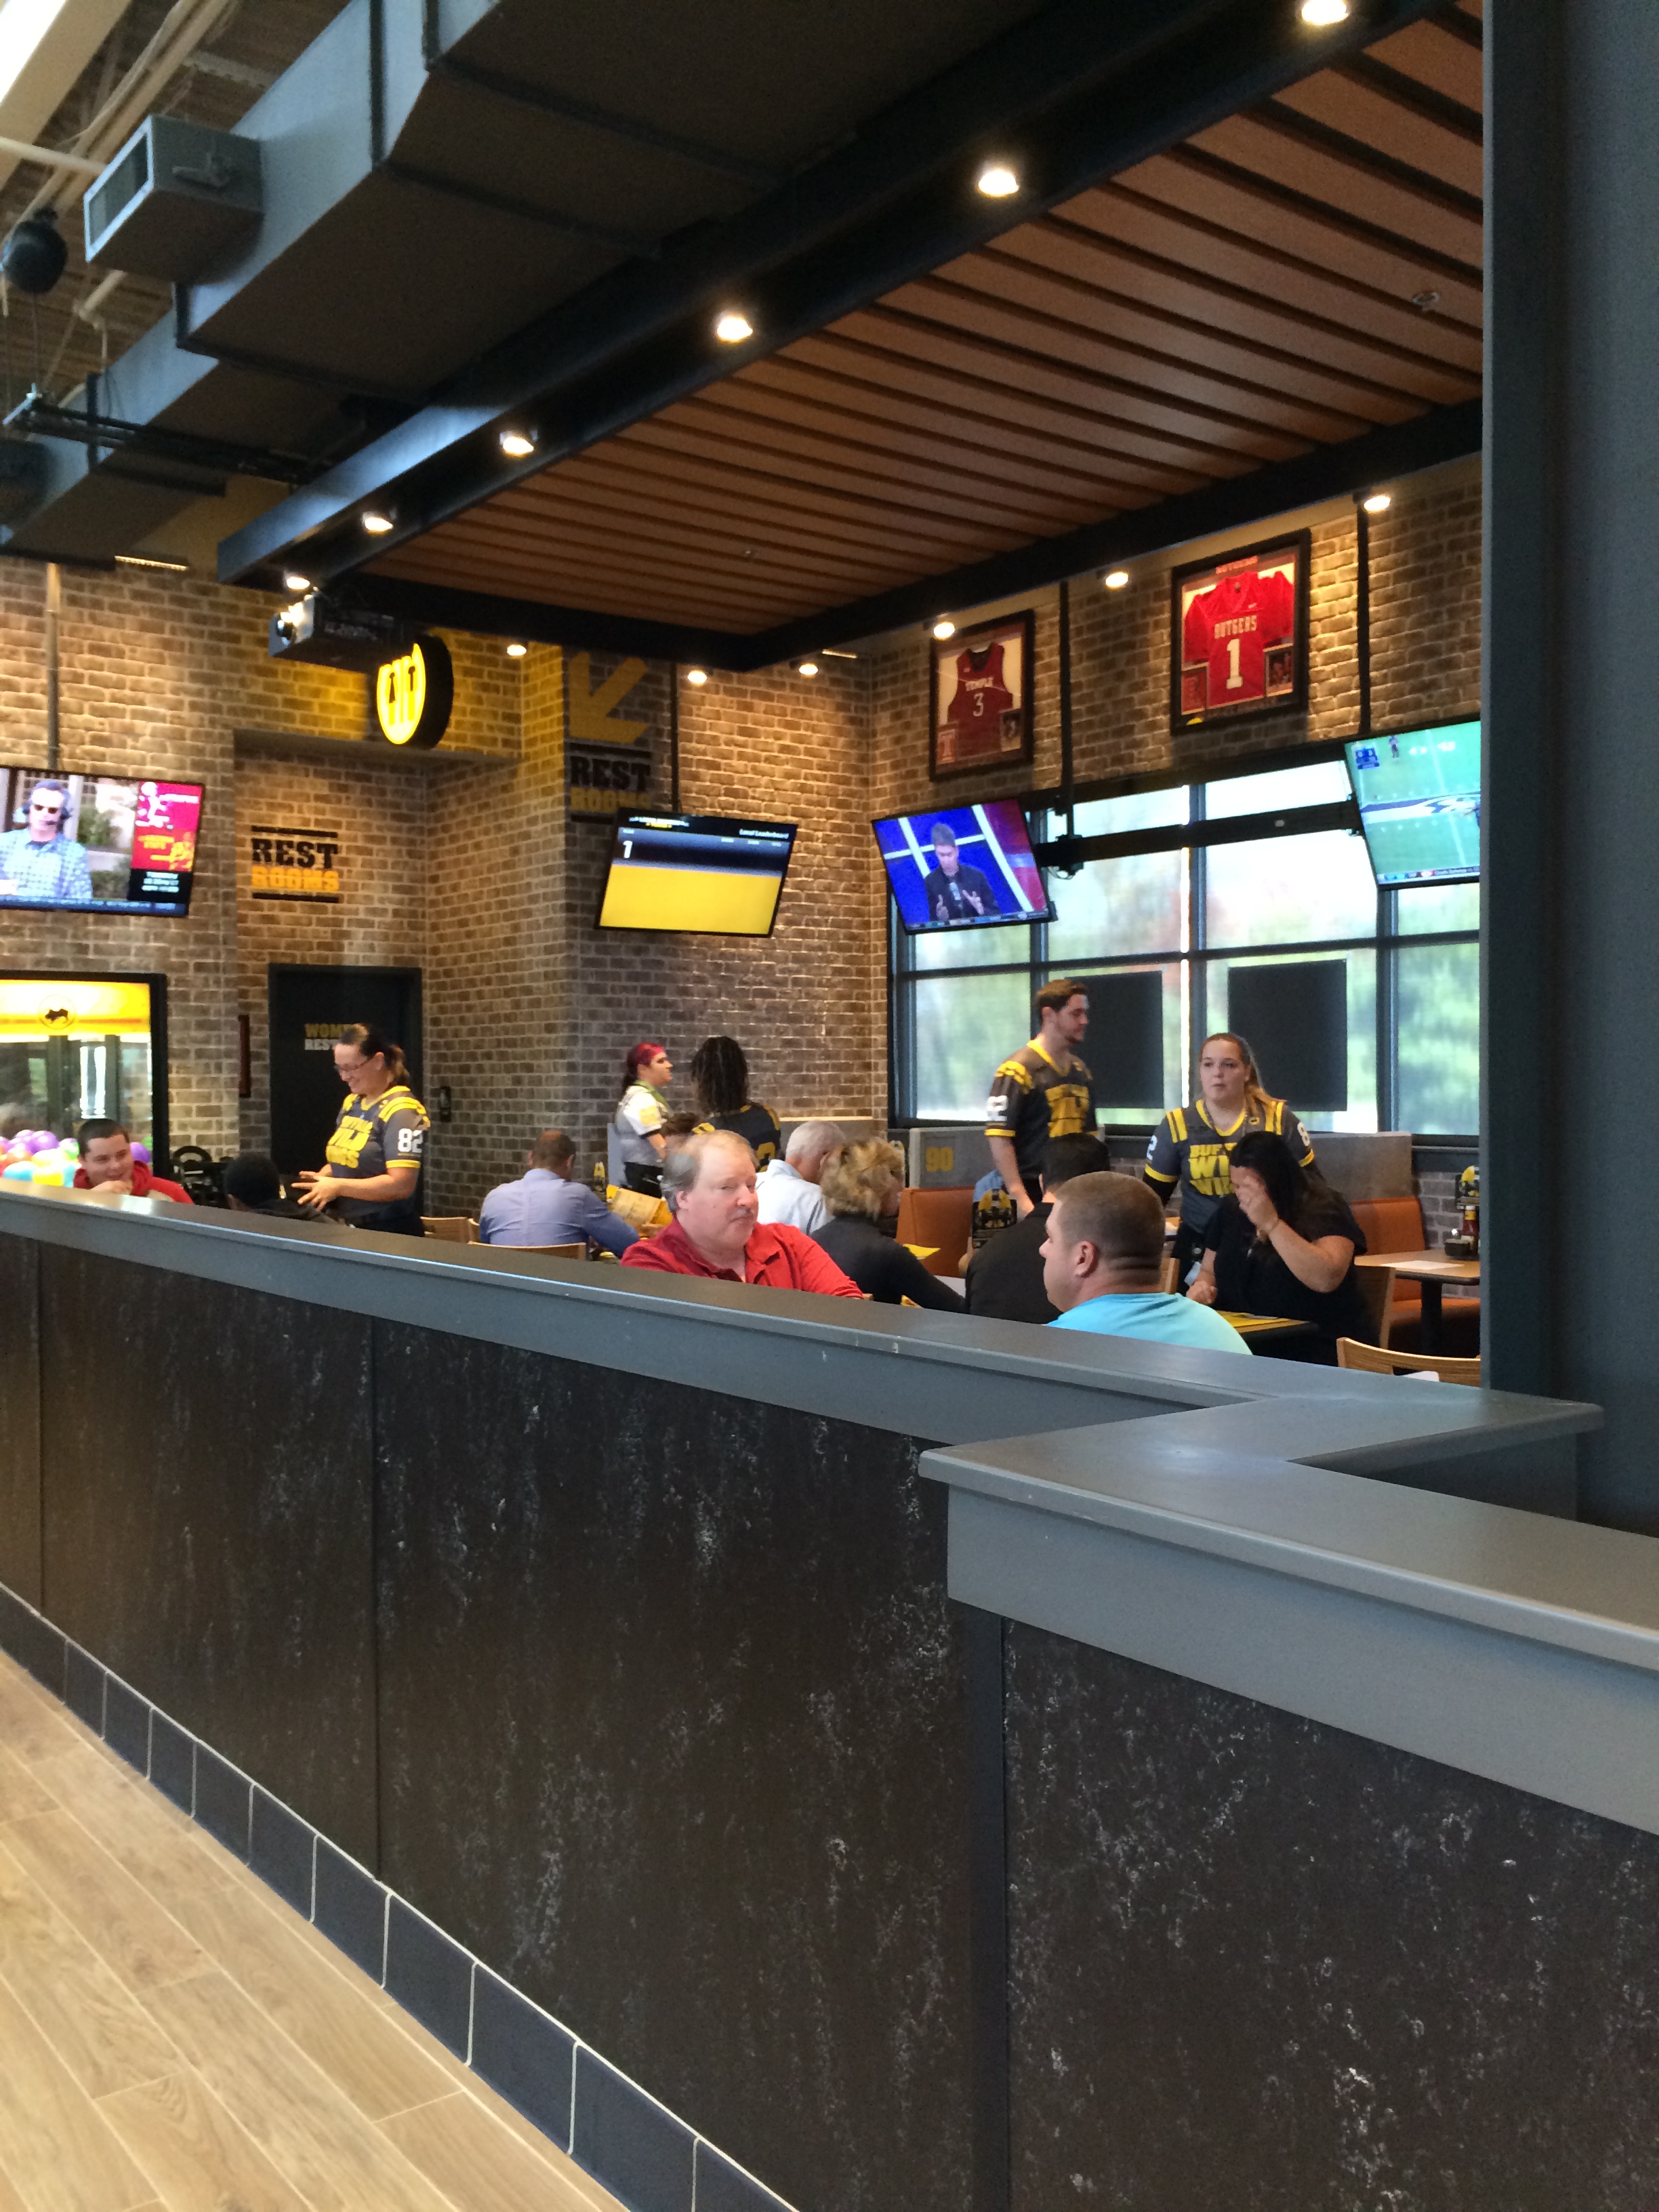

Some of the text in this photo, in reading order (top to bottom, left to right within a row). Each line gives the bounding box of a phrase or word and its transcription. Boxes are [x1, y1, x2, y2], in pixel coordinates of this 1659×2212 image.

[1214, 615, 1257, 639] RUTGERS
[1226, 638, 1243, 689] 1
[972, 692, 985, 717] 3
[570, 755, 651, 792] REST
[251, 838, 339, 869] REST
[622, 840, 633, 859] 1
[251, 865, 340, 893] ROOMS
[397, 1128, 424, 1153] 82
